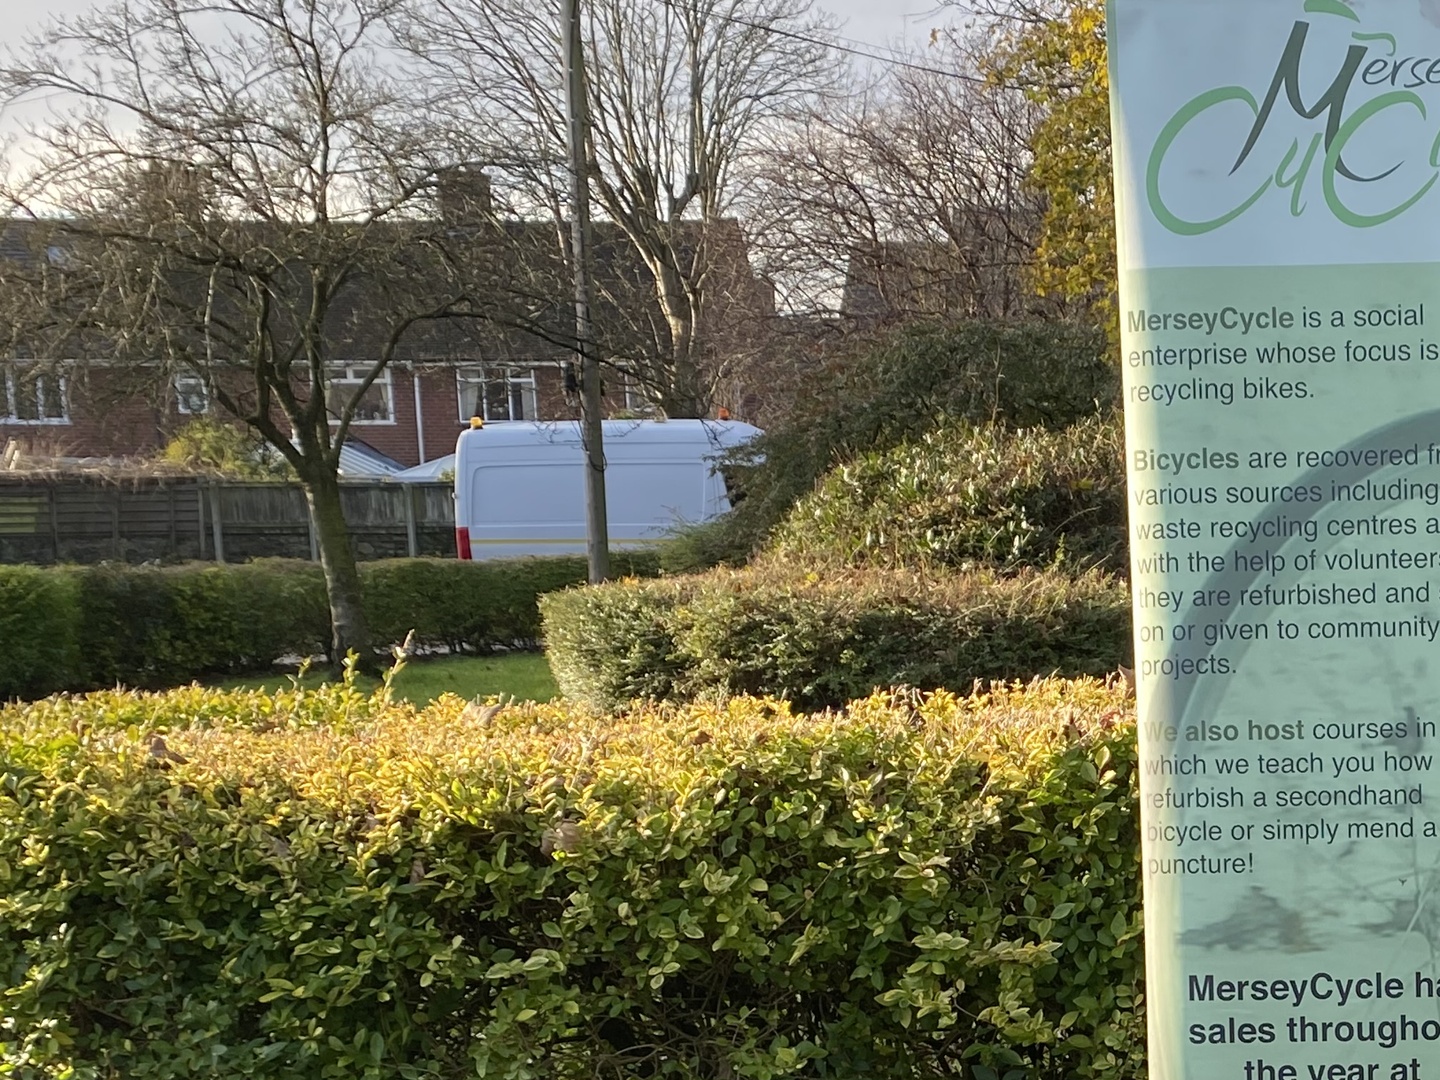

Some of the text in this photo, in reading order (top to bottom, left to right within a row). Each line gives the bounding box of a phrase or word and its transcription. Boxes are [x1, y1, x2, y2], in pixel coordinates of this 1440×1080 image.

[1127, 304, 1424, 335] MerseyCycle is a social
[1128, 344, 1247, 370] enterprise
[1256, 342, 1336, 364] whose
[1344, 340, 1411, 363] focus
[1420, 340, 1439, 361] is
[1130, 376, 1315, 405] recycling bikes.
[1133, 448, 1239, 475] Bicycles
[1248, 450, 1287, 468] are
[1296, 443, 1419, 467] recovered
[1134, 478, 1439, 506] various sources including
[1136, 519, 1201, 540] waste
[1210, 516, 1318, 543] recycling
[1327, 515, 1417, 536] centres
[1137, 552, 1179, 575] with
[1187, 550, 1225, 573] the
[1234, 549, 1285, 577] help
[1294, 549, 1316, 572] of
[1139, 586, 1184, 612] they
[1192, 588, 1231, 607] are
[1240, 582, 1376, 606] refurbished
[1385, 581, 1430, 604] and
[1140, 616, 1440, 646] on or given to community
[1141, 654, 1237, 681] projects.
[1144, 717, 1436, 742] We also host courses in
[1144, 754, 1207, 776] which
[1215, 756, 1250, 775] we
[1258, 752, 1324, 774] teach
[1332, 755, 1375, 778] you
[1384, 751, 1433, 772] how
[1146, 783, 1423, 809] refurbish a secondhand
[1147, 817, 1438, 846] bicycle or simply mend a
[1148, 853, 1255, 880] puncture!
[1188, 971, 1404, 1006] MerseyCycle
[1188, 1017, 1275, 1045] sales
